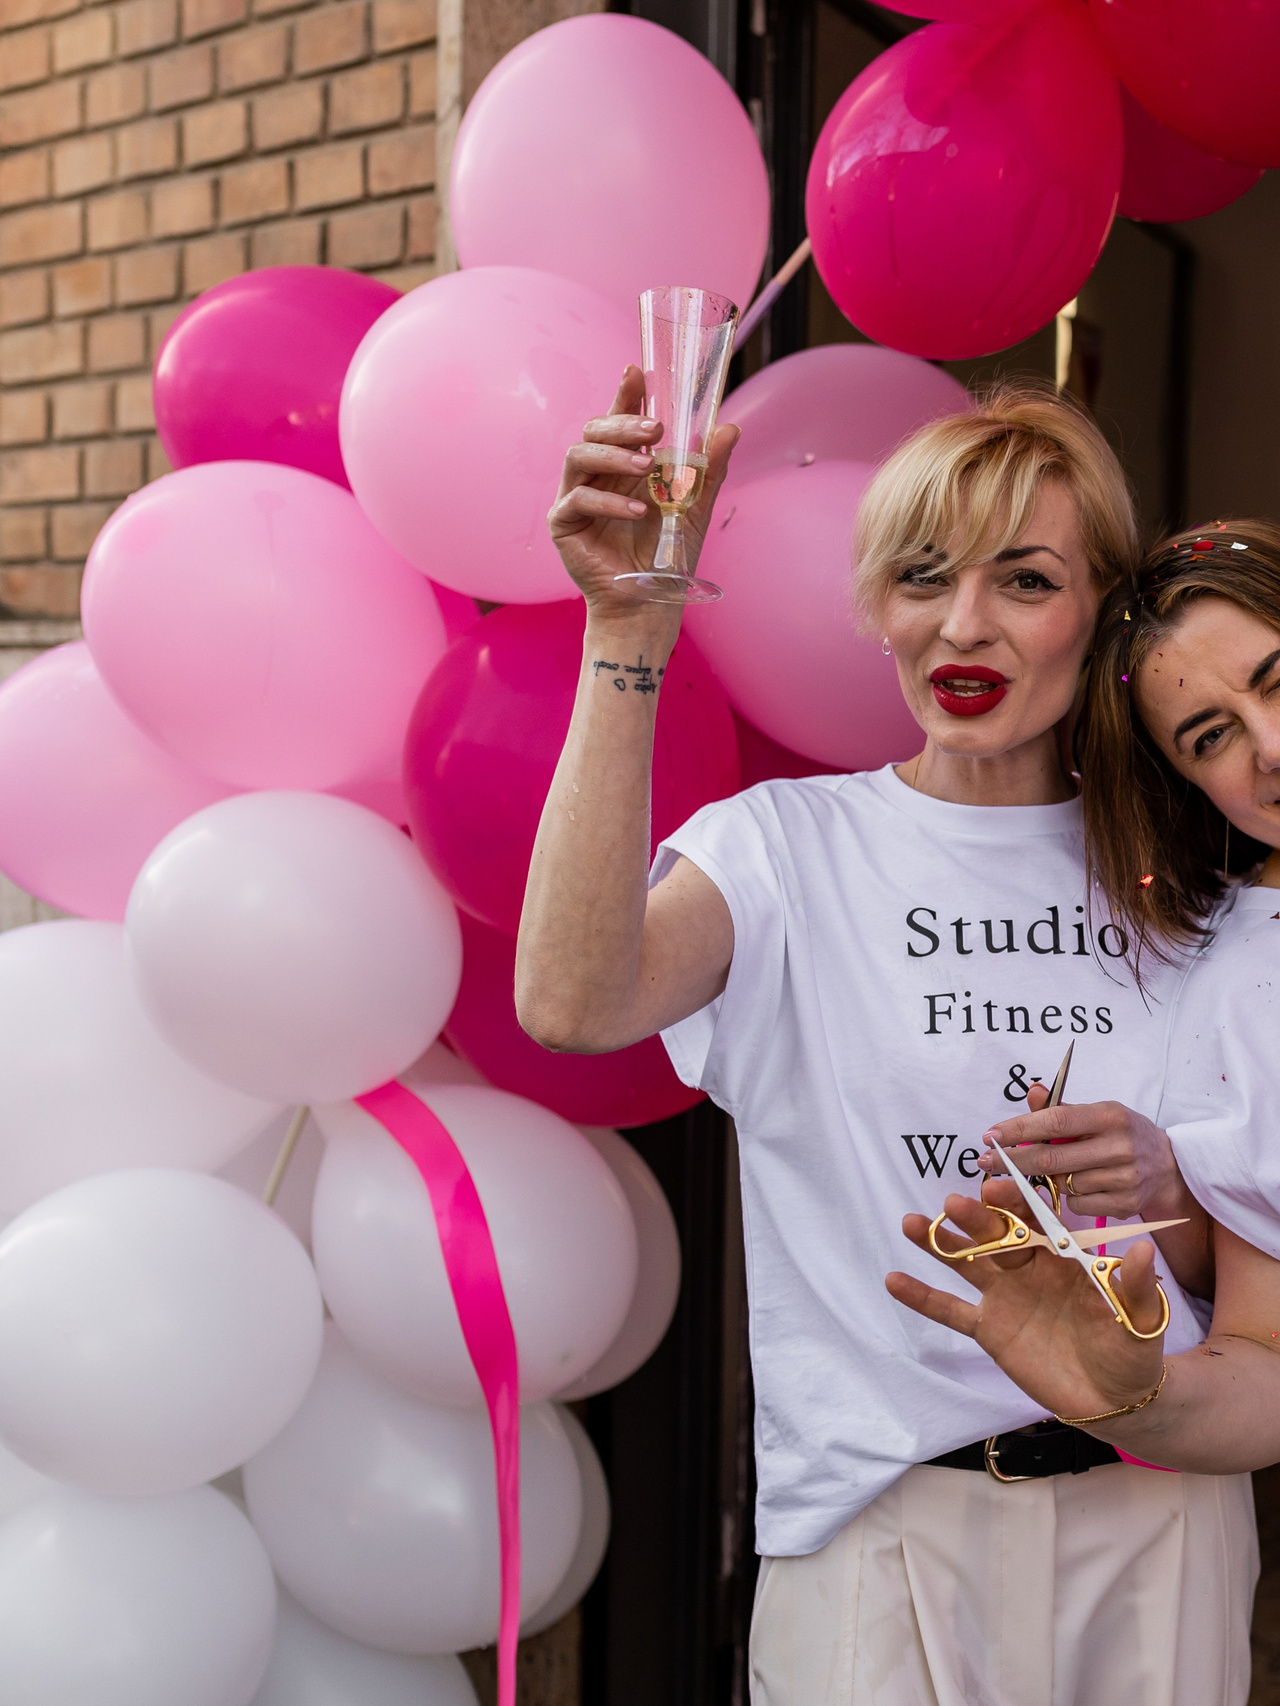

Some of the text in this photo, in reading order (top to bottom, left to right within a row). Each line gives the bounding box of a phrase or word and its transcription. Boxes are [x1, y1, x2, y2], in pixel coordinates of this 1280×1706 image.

[905, 905, 1129, 958] Studio
[923, 990, 1114, 1035] Fitness
[1003, 1063, 1043, 1102] &
